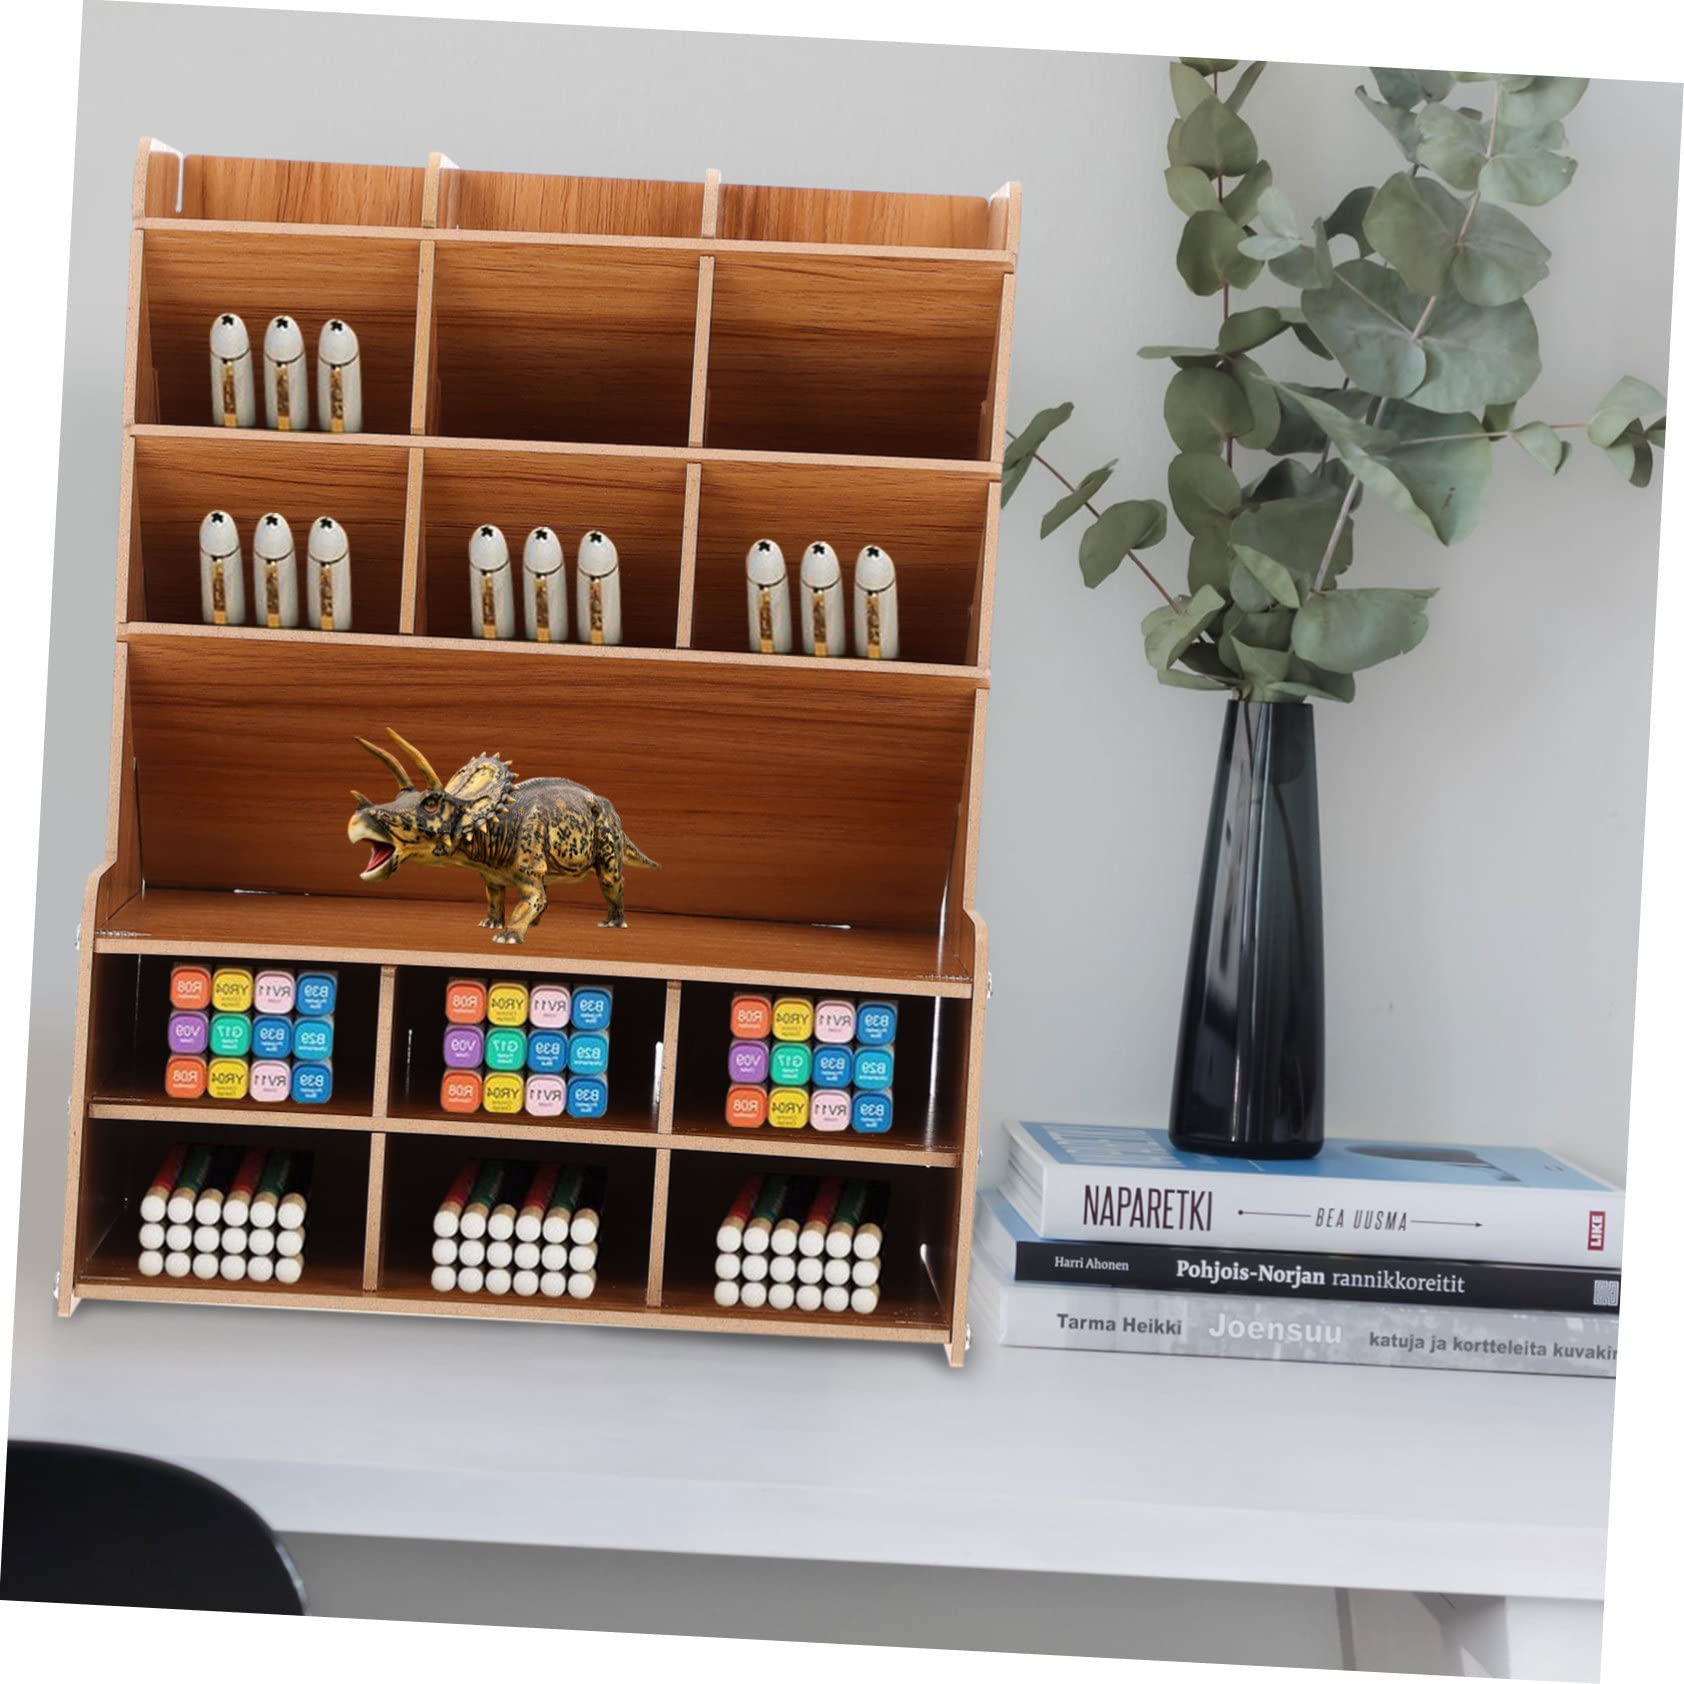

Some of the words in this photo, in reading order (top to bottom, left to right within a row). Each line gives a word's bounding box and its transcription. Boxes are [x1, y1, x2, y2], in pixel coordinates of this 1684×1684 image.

[1083, 1184, 1213, 1231] NAPARETKI
[1315, 1207, 1344, 1229] BEA
[1353, 1209, 1408, 1231] UUSMA
[1590, 1215, 1603, 1247] LIKE
[1054, 1256, 1084, 1269] Harri
[1085, 1257, 1129, 1271] Ahonen
[1176, 1259, 1325, 1288] Pohjois-Norjan
[1332, 1269, 1466, 1294] rannikkoreitit
[1057, 1313, 1116, 1332] Tarma
[1122, 1316, 1182, 1335] Heikki
[1208, 1313, 1342, 1343] Joensuu
[1369, 1331, 1425, 1351] katuja
[1430, 1334, 1447, 1353] ja
[1452, 1336, 1548, 1357] kortteleita
